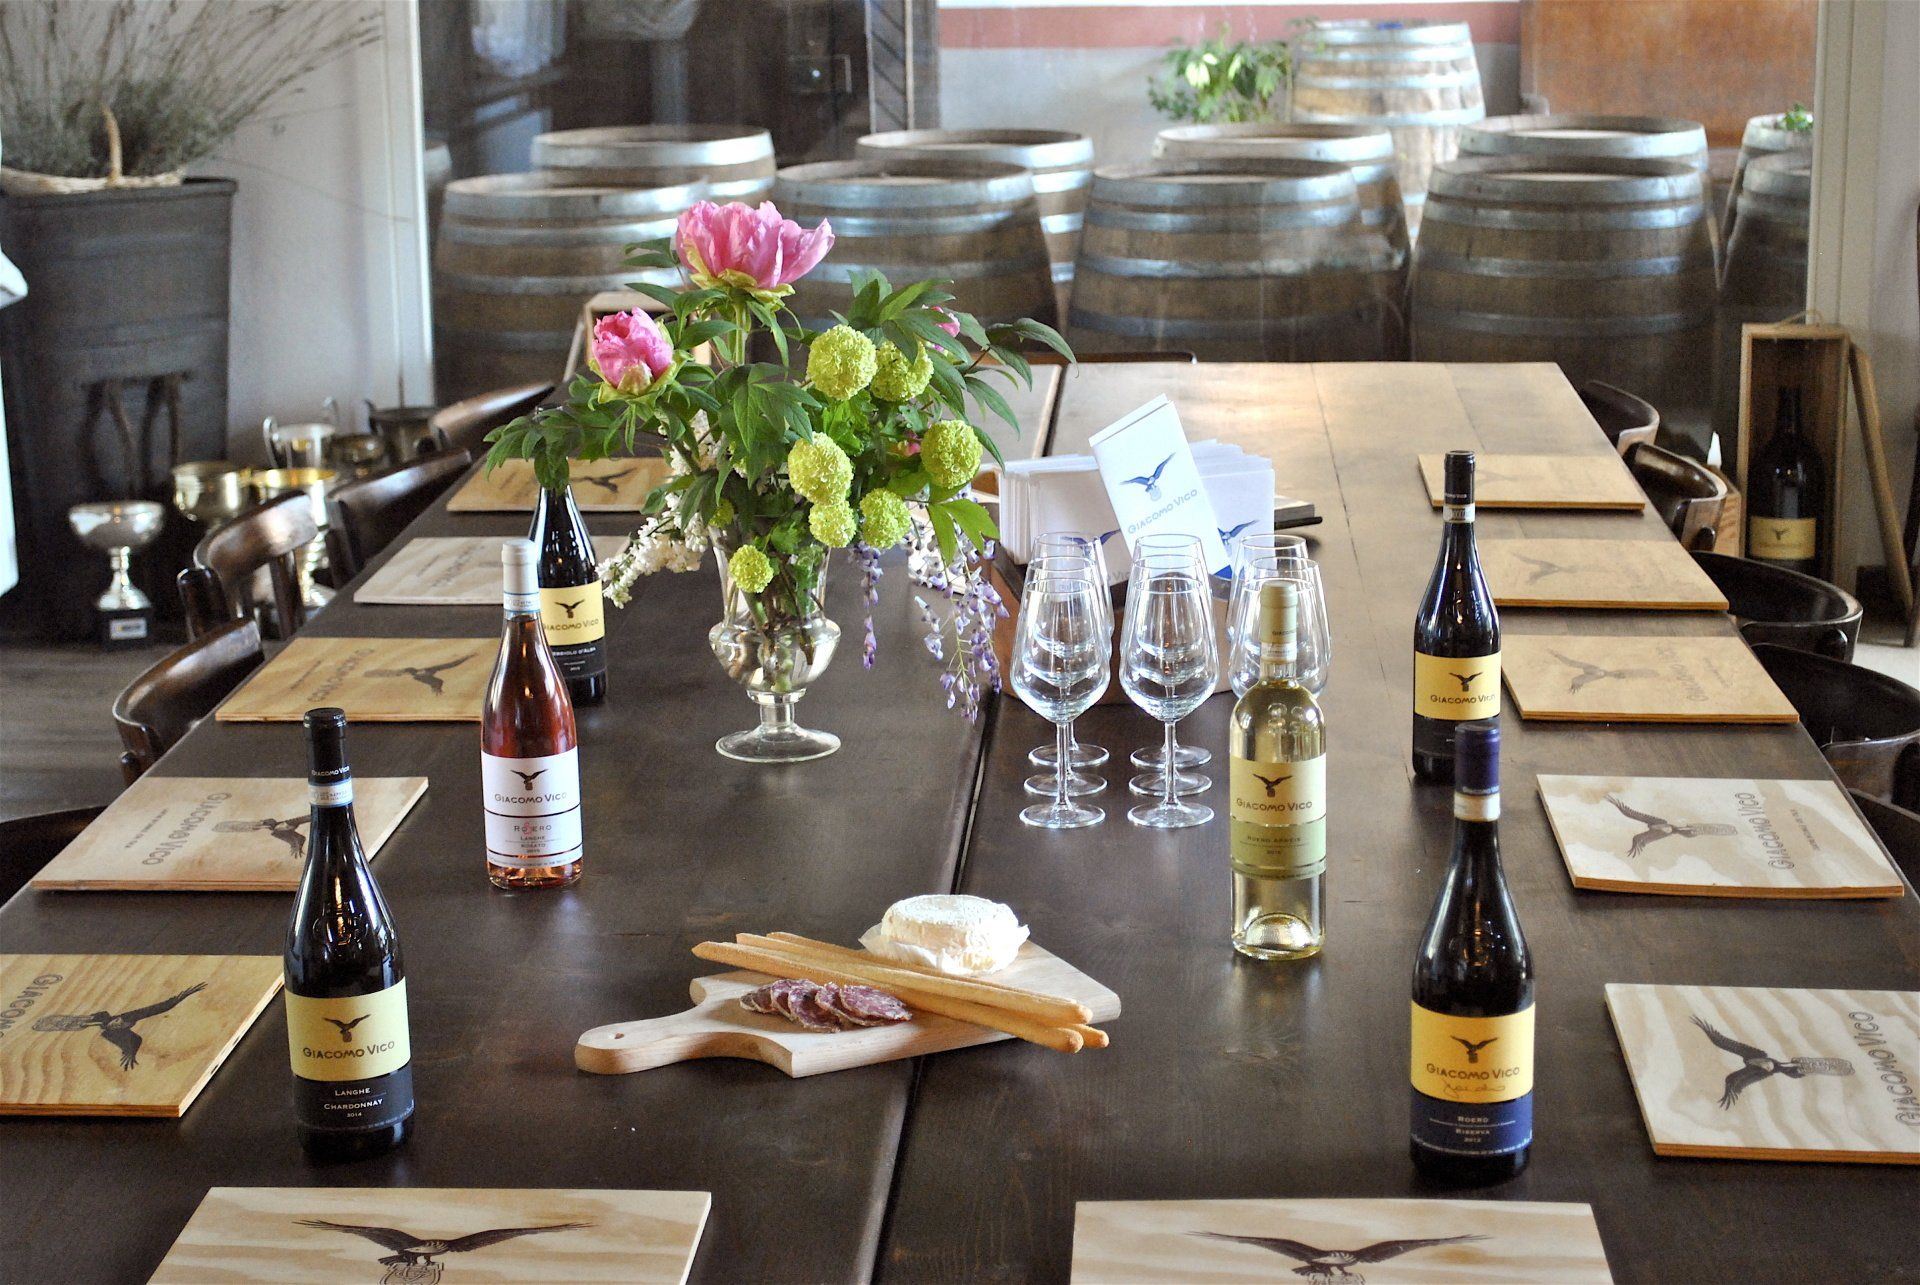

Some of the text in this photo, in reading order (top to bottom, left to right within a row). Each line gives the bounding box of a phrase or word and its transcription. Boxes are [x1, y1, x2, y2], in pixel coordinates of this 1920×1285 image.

[1128, 489, 1198, 534] GIACOMO VICO
[583, 619, 599, 628] VICO
[1430, 695, 1477, 704] GIACOMO
[495, 792, 567, 804] GIACOMO VICO
[1237, 798, 1313, 812] GIACOMO VICO
[168, 792, 232, 839] GIACOMO
[1735, 792, 1795, 869] GIACOMO VICO
[142, 840, 188, 865] VICO
[303, 1041, 395, 1059] GIACOMO VICO
[1426, 1063, 1520, 1080] GIACOMO VICO
[1849, 1011, 1920, 1126] GIACOMO VICO
[335, 1087, 371, 1096] LANGHE
[323, 1099, 383, 1111] CHARDONNAY
